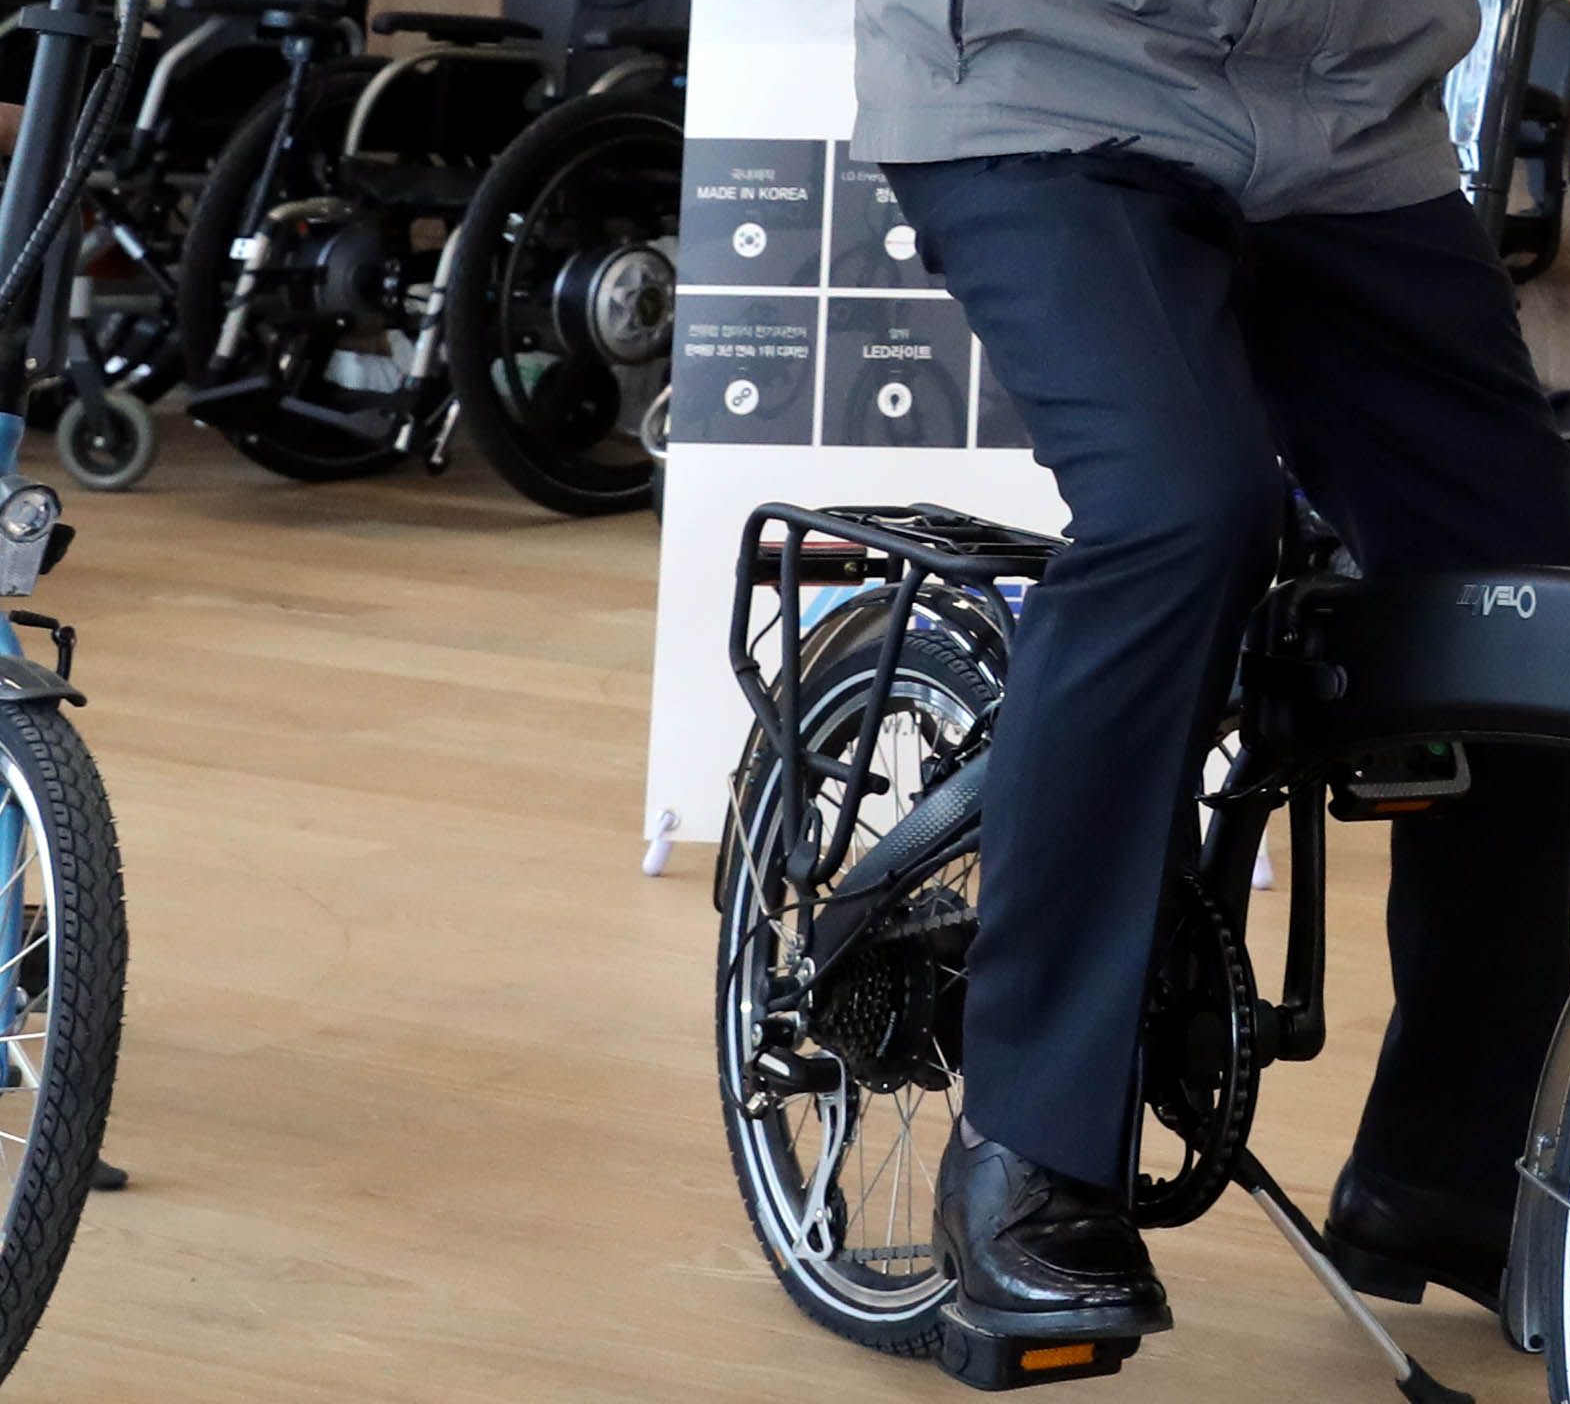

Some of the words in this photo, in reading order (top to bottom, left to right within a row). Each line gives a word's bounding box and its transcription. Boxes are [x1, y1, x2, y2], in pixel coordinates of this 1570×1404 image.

[697, 186, 737, 200] MADE
[739, 187, 755, 200] IN
[758, 187, 808, 201] KOREA
[863, 343, 934, 360] LED라이트
